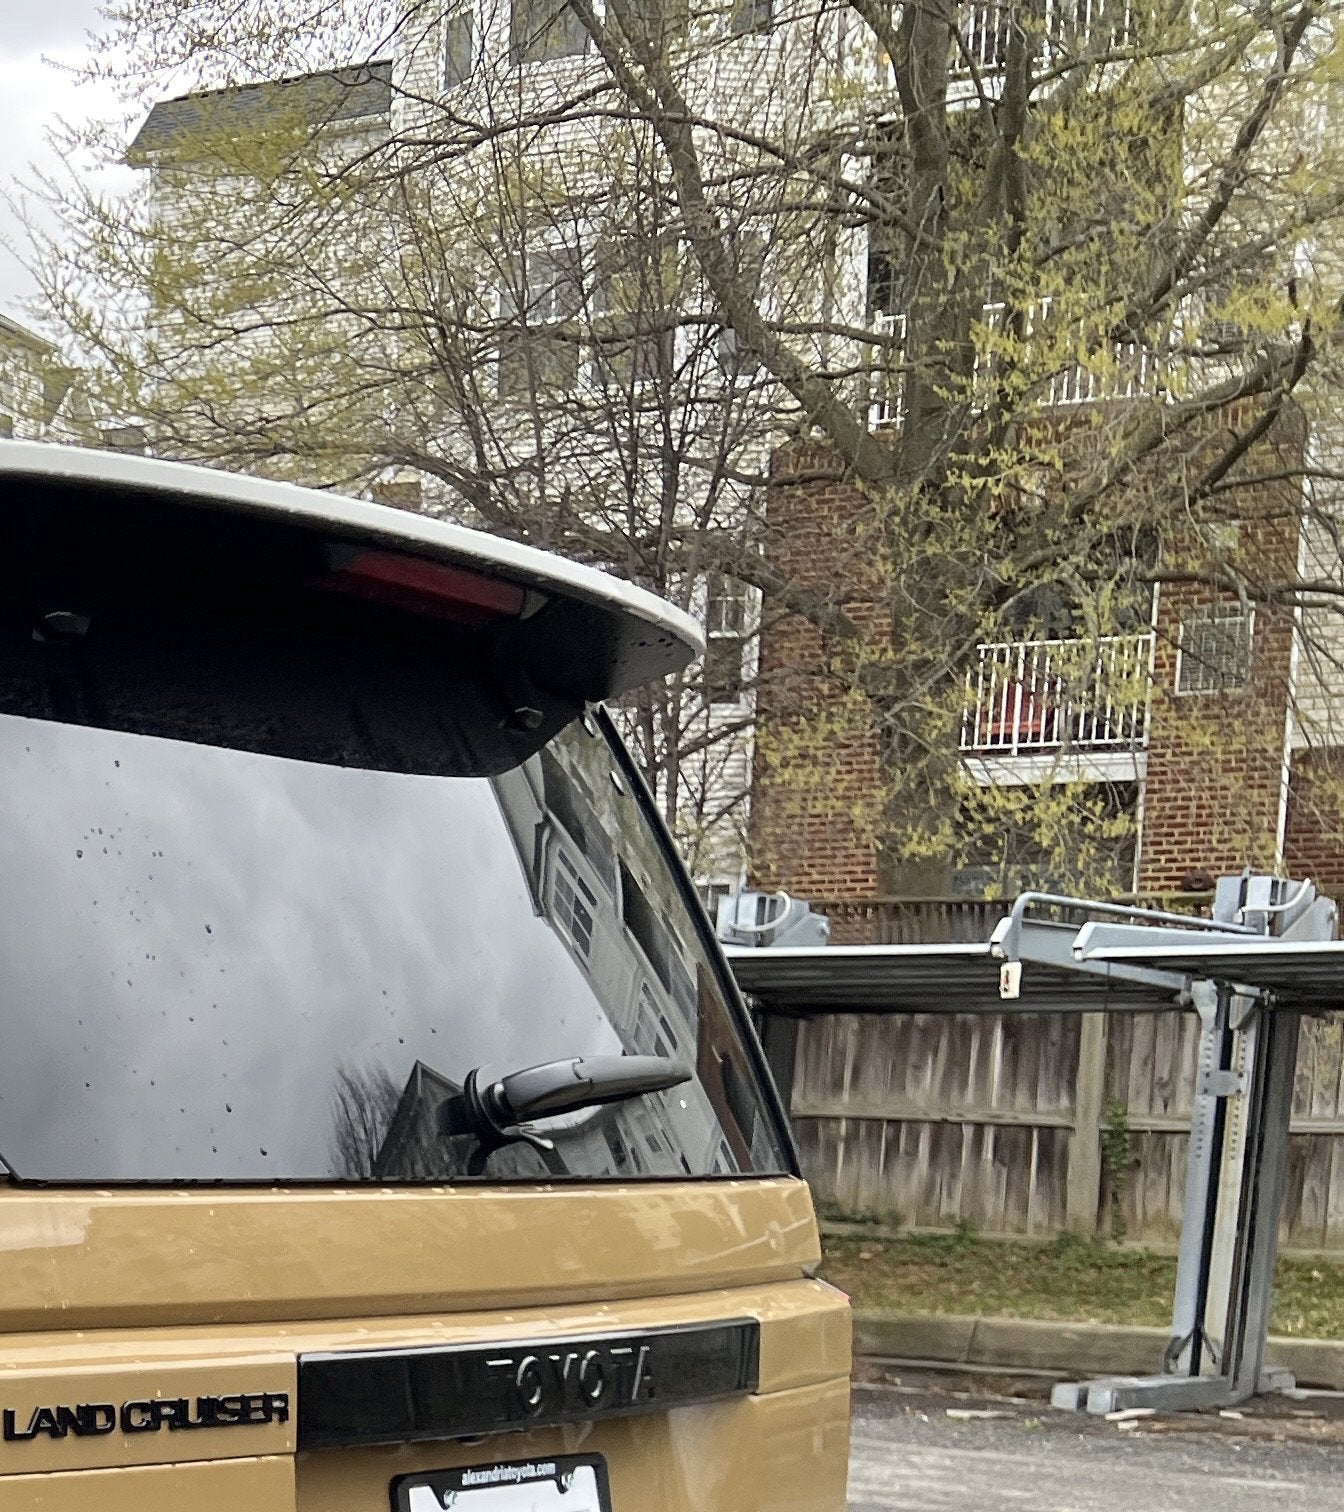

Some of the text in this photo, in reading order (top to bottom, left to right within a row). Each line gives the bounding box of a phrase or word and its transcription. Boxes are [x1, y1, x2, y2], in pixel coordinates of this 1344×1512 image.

[486, 1346, 654, 1416] TOYOTA
[3, 1392, 290, 1441] LAND CRUISER
[462, 1463, 556, 1486] alexandriatoyota.com
